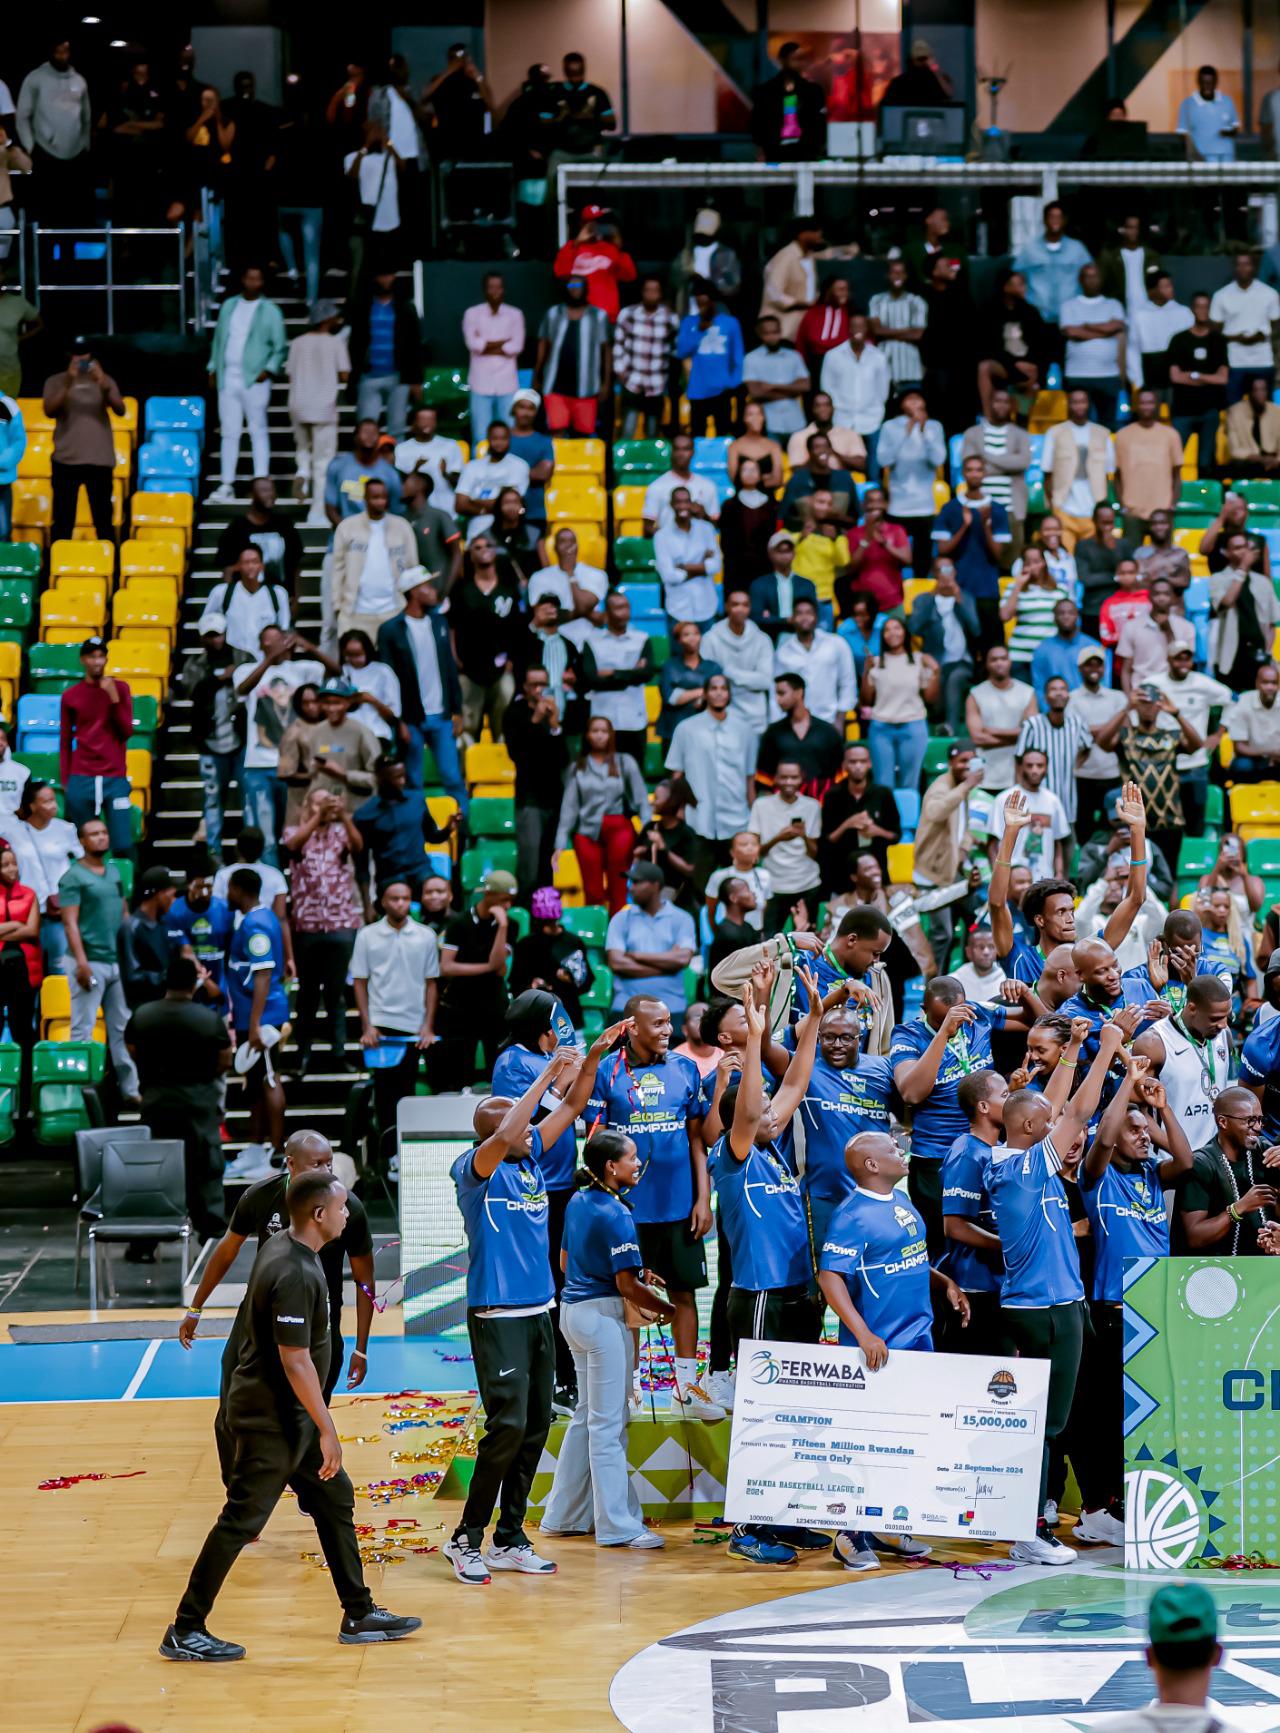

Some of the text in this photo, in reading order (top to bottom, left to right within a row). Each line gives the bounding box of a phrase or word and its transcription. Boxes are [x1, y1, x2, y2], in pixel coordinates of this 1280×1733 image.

[839, 1092, 885, 1110] 2024
[1184, 1103, 1209, 1117] APR
[942, 1187, 982, 1201] betPawa
[781, 1359, 866, 1381] FERWABA
[774, 1413, 833, 1426] CHAMPION
[963, 1415, 1028, 1429] 15,000,000
[792, 1438, 826, 1449] Fifteen
[830, 1441, 866, 1452] Million
[868, 1444, 915, 1455] Rwandan
[794, 1452, 853, 1465] Francs Only
[964, 1464, 1005, 1474] September
[1005, 1466, 1024, 1474] 2024
[746, 1479, 776, 1488] RWANDA
[779, 1481, 825, 1491] BASKETBALL
[827, 1484, 855, 1493] LEAGUE
[746, 1488, 764, 1496] 2024
